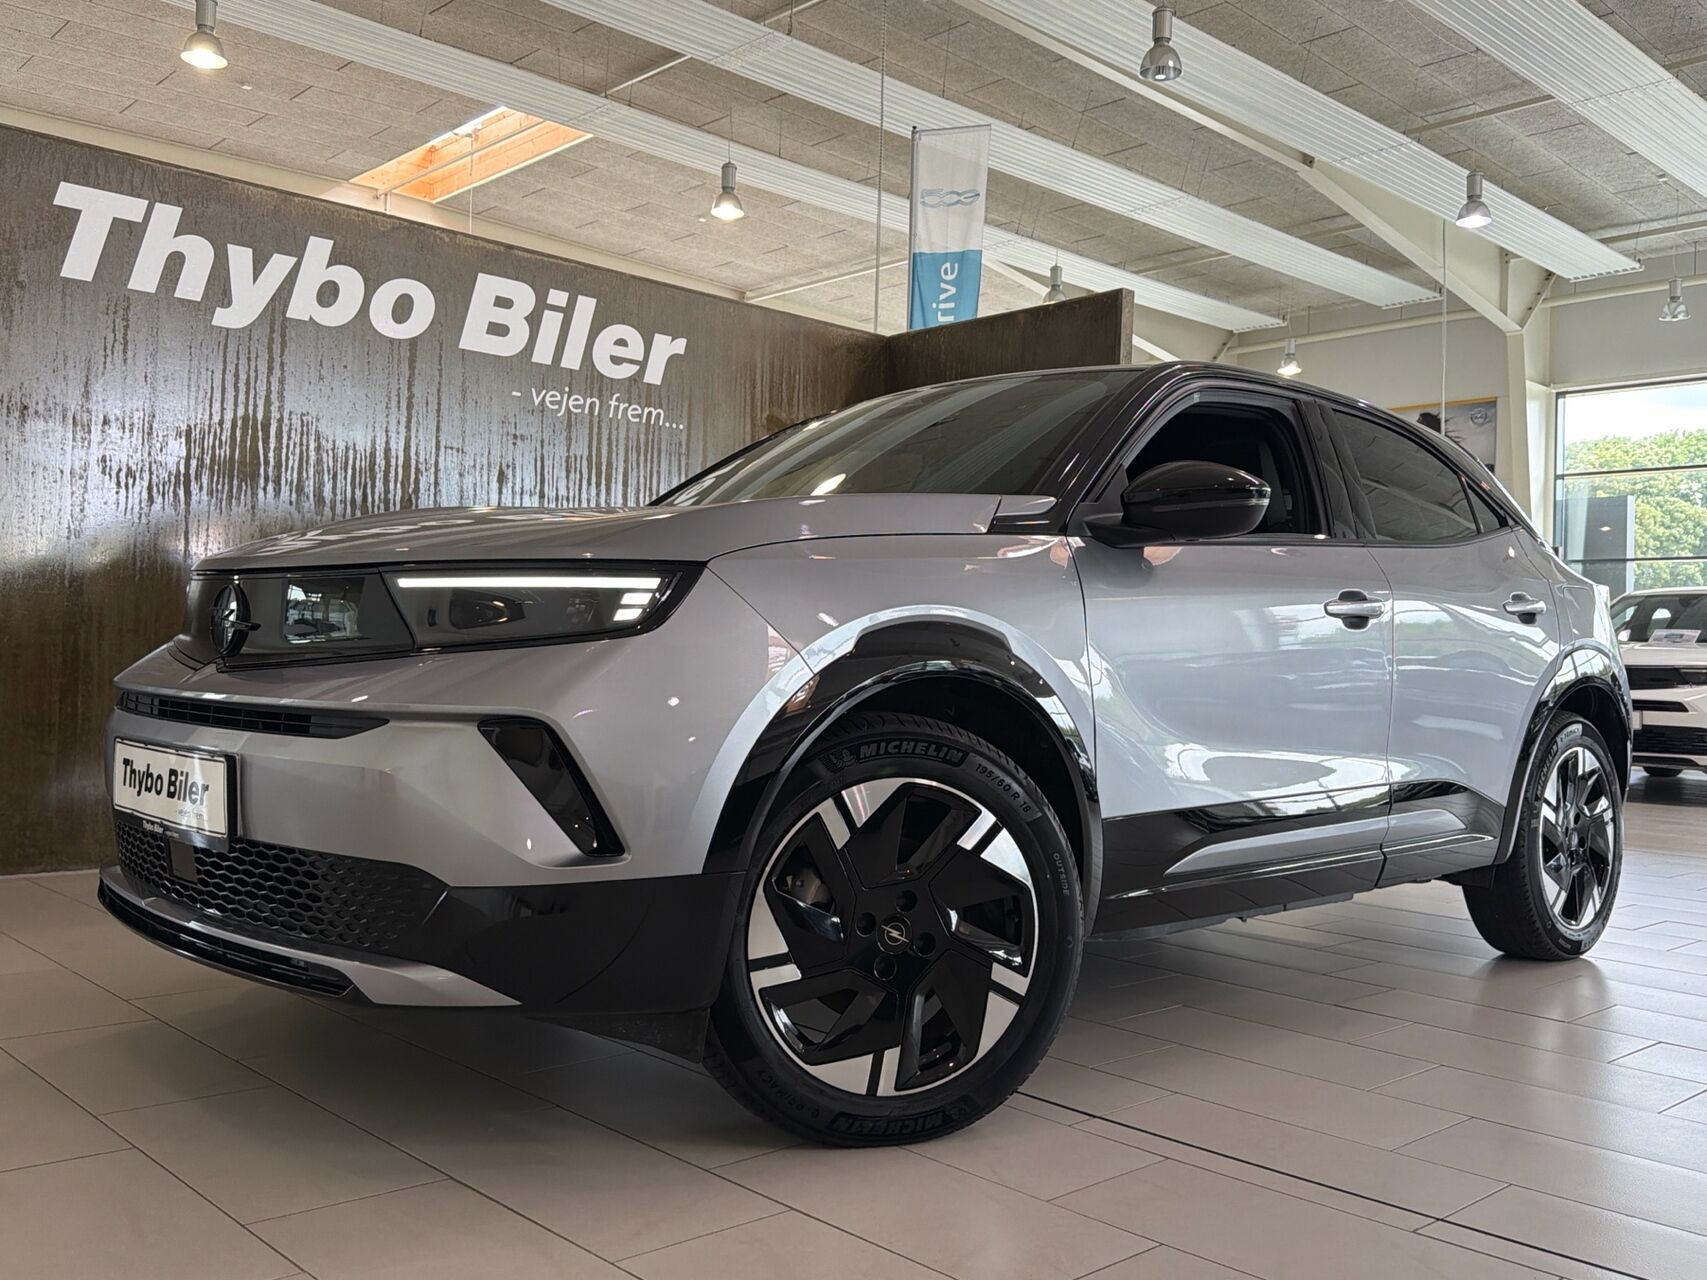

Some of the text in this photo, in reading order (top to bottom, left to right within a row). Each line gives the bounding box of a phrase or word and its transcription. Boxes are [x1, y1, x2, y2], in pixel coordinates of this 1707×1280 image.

[52, 181, 688, 386] Thybo Biler
[531, 386, 601, 417] vejen
[608, 393, 684, 430] frem...
[859, 740, 967, 763] MICHELIN
[122, 757, 210, 806] Thybo Biler
[975, 762, 1032, 813] 195/60 R 18
[1053, 852, 1070, 896] OUTSIDE
